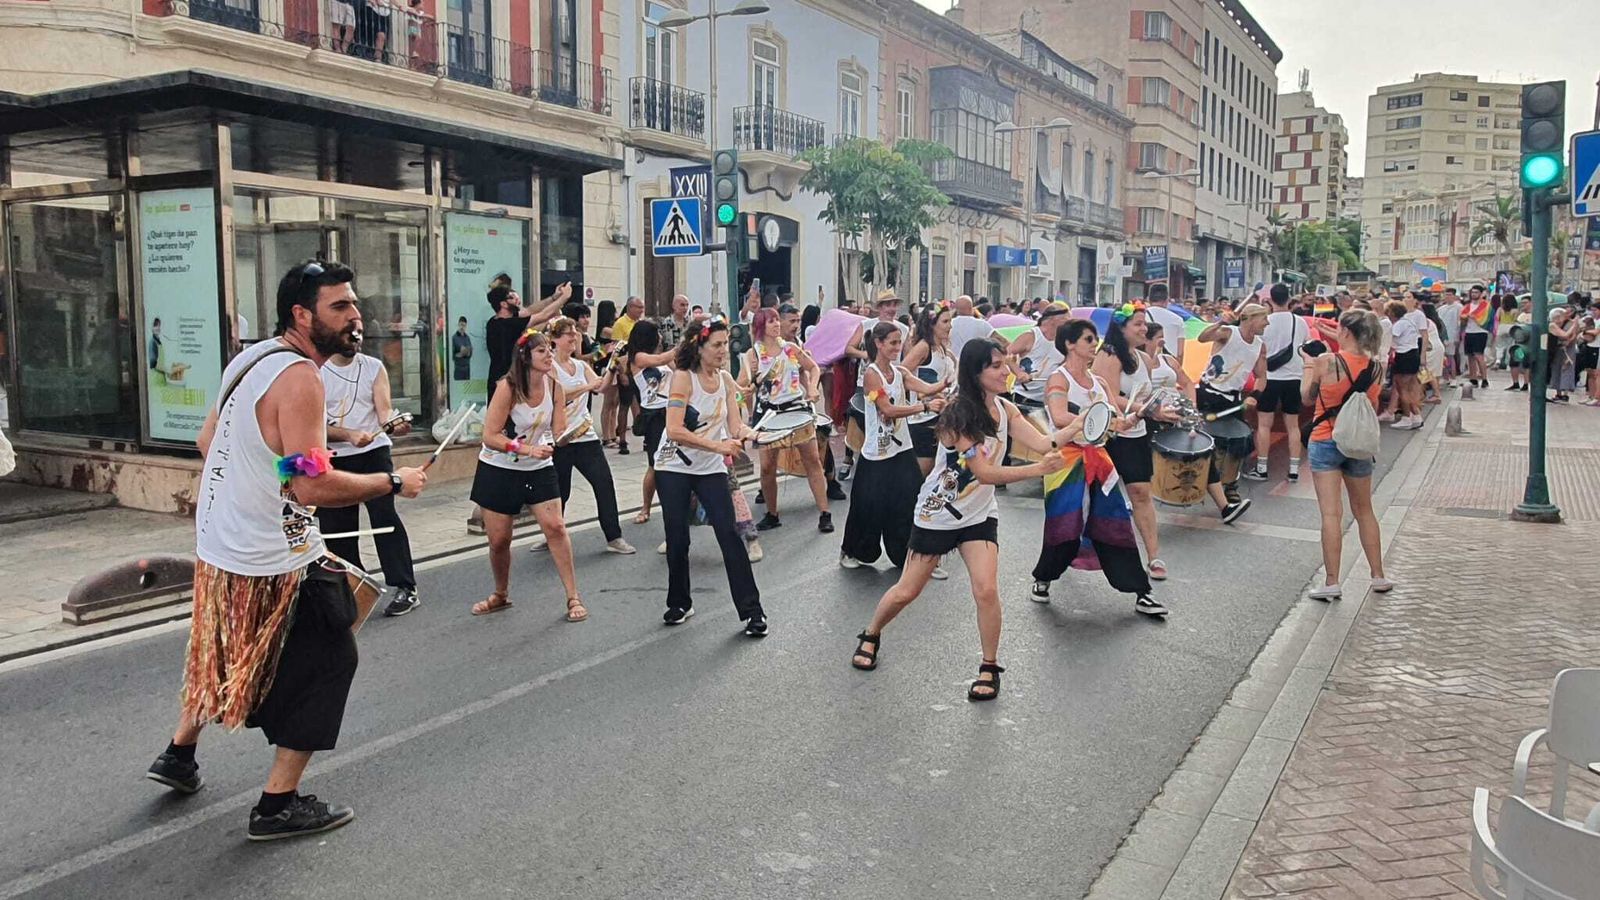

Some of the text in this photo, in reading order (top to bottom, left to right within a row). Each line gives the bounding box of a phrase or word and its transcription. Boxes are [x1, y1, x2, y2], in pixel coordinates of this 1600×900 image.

[675, 173, 708, 197] XXIII
[163, 230, 176, 240] tipo
[176, 229, 185, 237] de
[185, 230, 198, 239] pan
[154, 243, 178, 251] apetece
[179, 240, 194, 251] hoy?
[453, 246, 470, 255] ¿Hoy
[1145, 246, 1166, 257] XXIII
[160, 254, 183, 263] quieres
